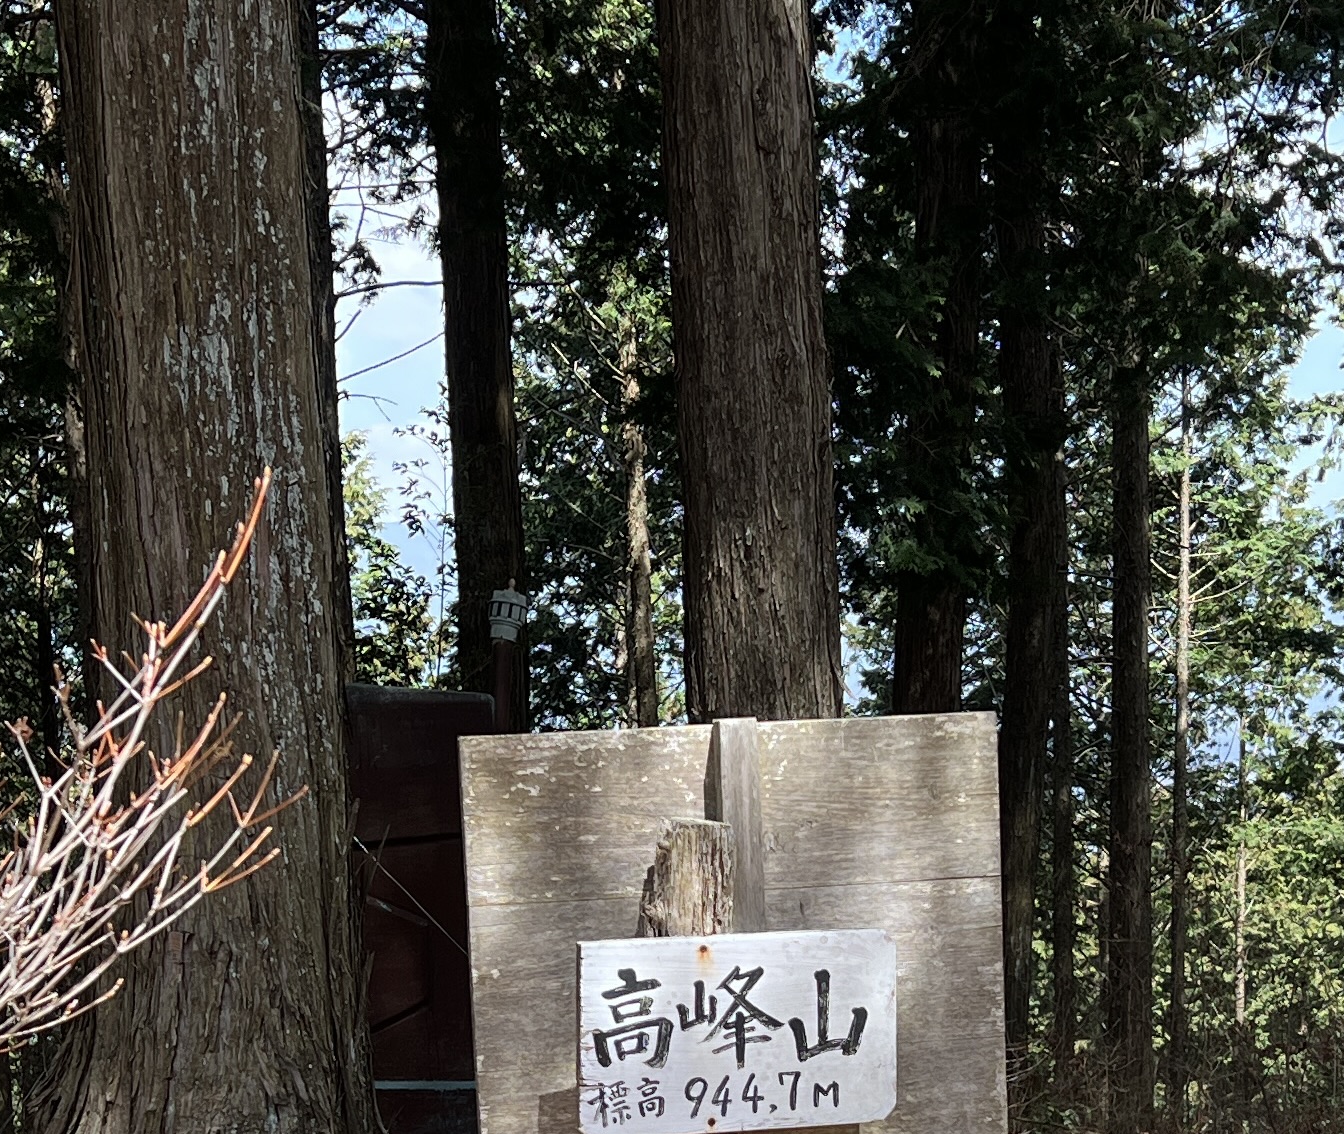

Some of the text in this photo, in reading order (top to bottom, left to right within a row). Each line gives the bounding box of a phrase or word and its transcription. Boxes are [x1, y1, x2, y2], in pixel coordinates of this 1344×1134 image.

[593, 965, 868, 1069] 高峰山
[587, 1077, 665, 1128] 標高
